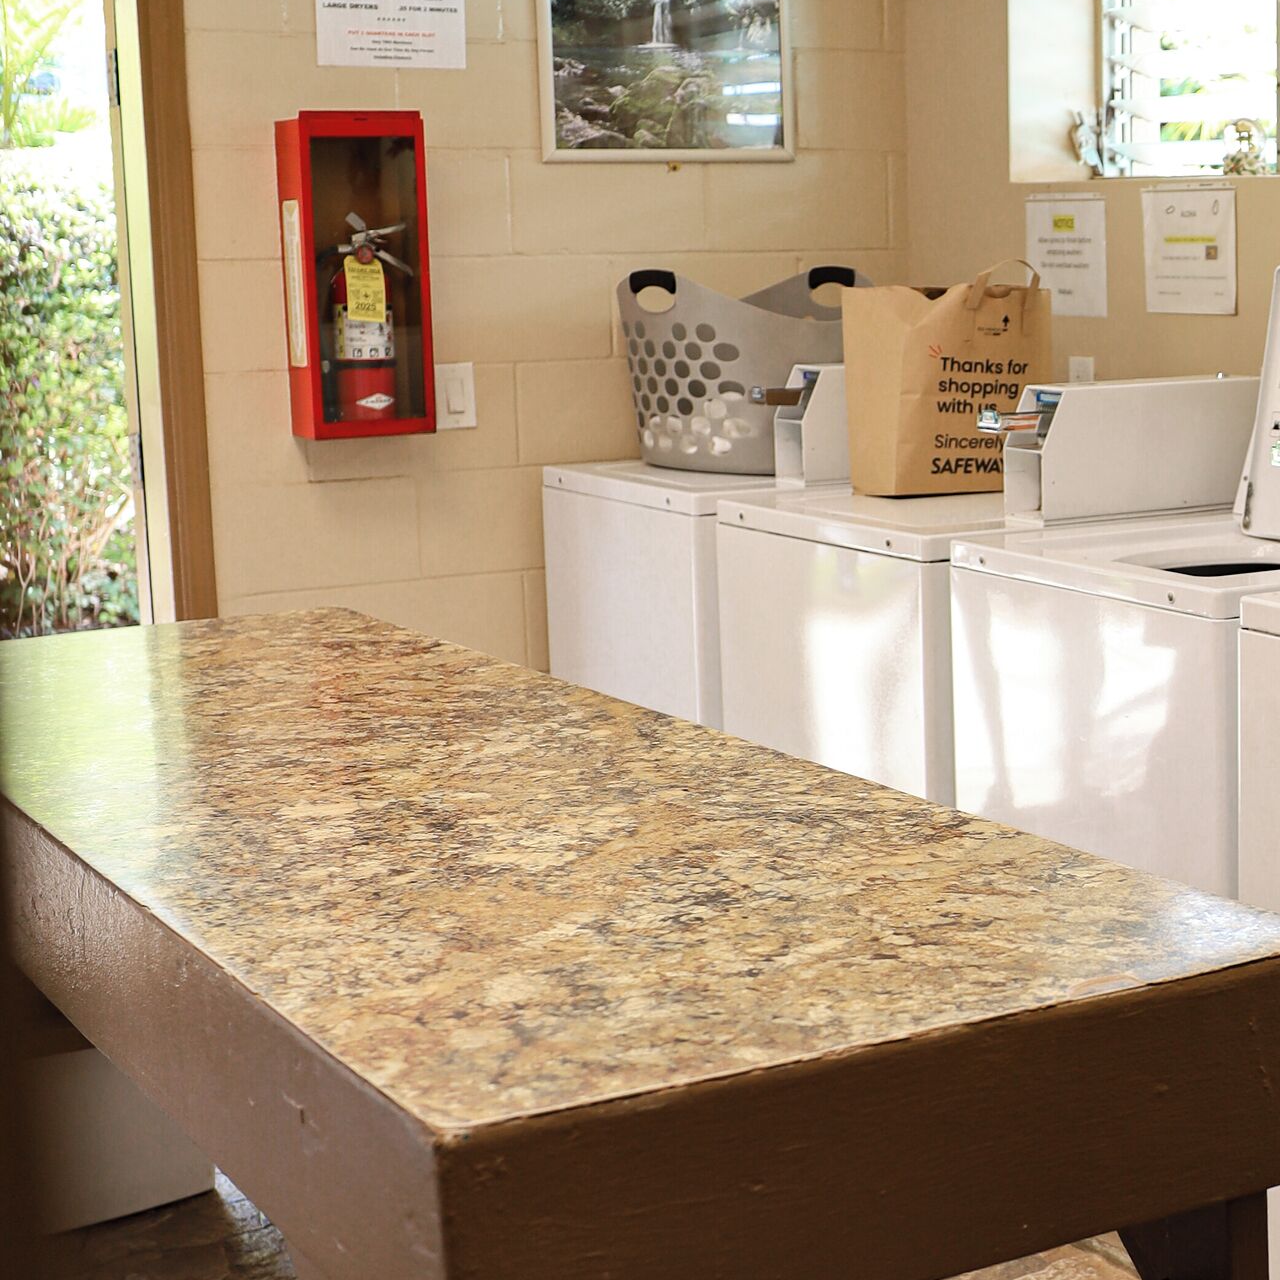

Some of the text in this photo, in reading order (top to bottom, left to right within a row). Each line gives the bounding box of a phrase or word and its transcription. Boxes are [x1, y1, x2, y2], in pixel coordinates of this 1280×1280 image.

[941, 357, 1029, 375] Thanks for
[938, 378, 1019, 399] shopping
[937, 398, 973, 414] with
